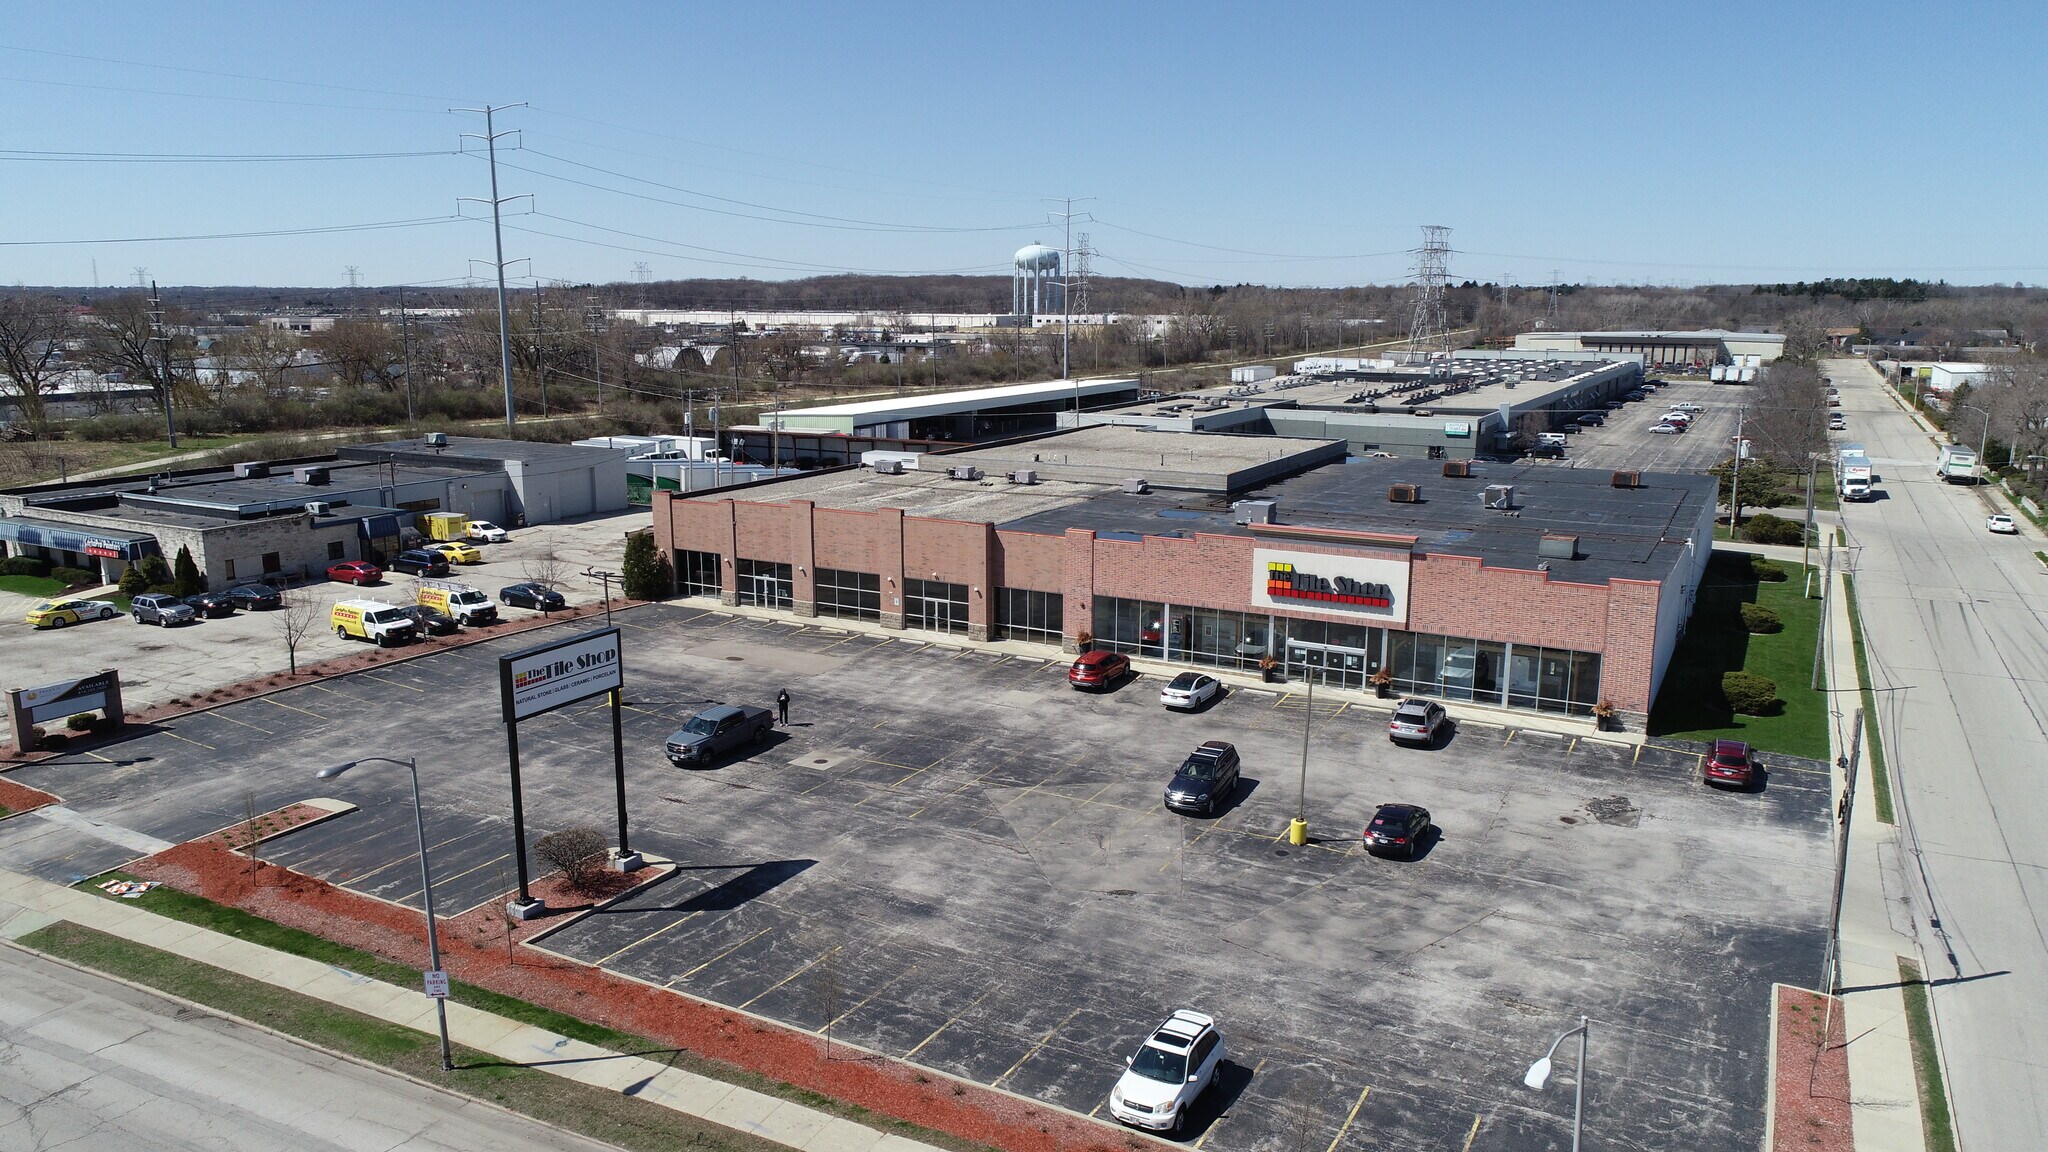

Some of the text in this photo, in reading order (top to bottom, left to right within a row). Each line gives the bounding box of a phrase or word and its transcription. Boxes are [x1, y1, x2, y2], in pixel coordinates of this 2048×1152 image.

[1269, 570, 1390, 598] The Tile Shop
[527, 648, 616, 680] The Tile Shop
[78, 681, 109, 691] AVAILABLE
[515, 669, 617, 706] NATURAL STONE GLASS CERAMIC PORCELAIN
